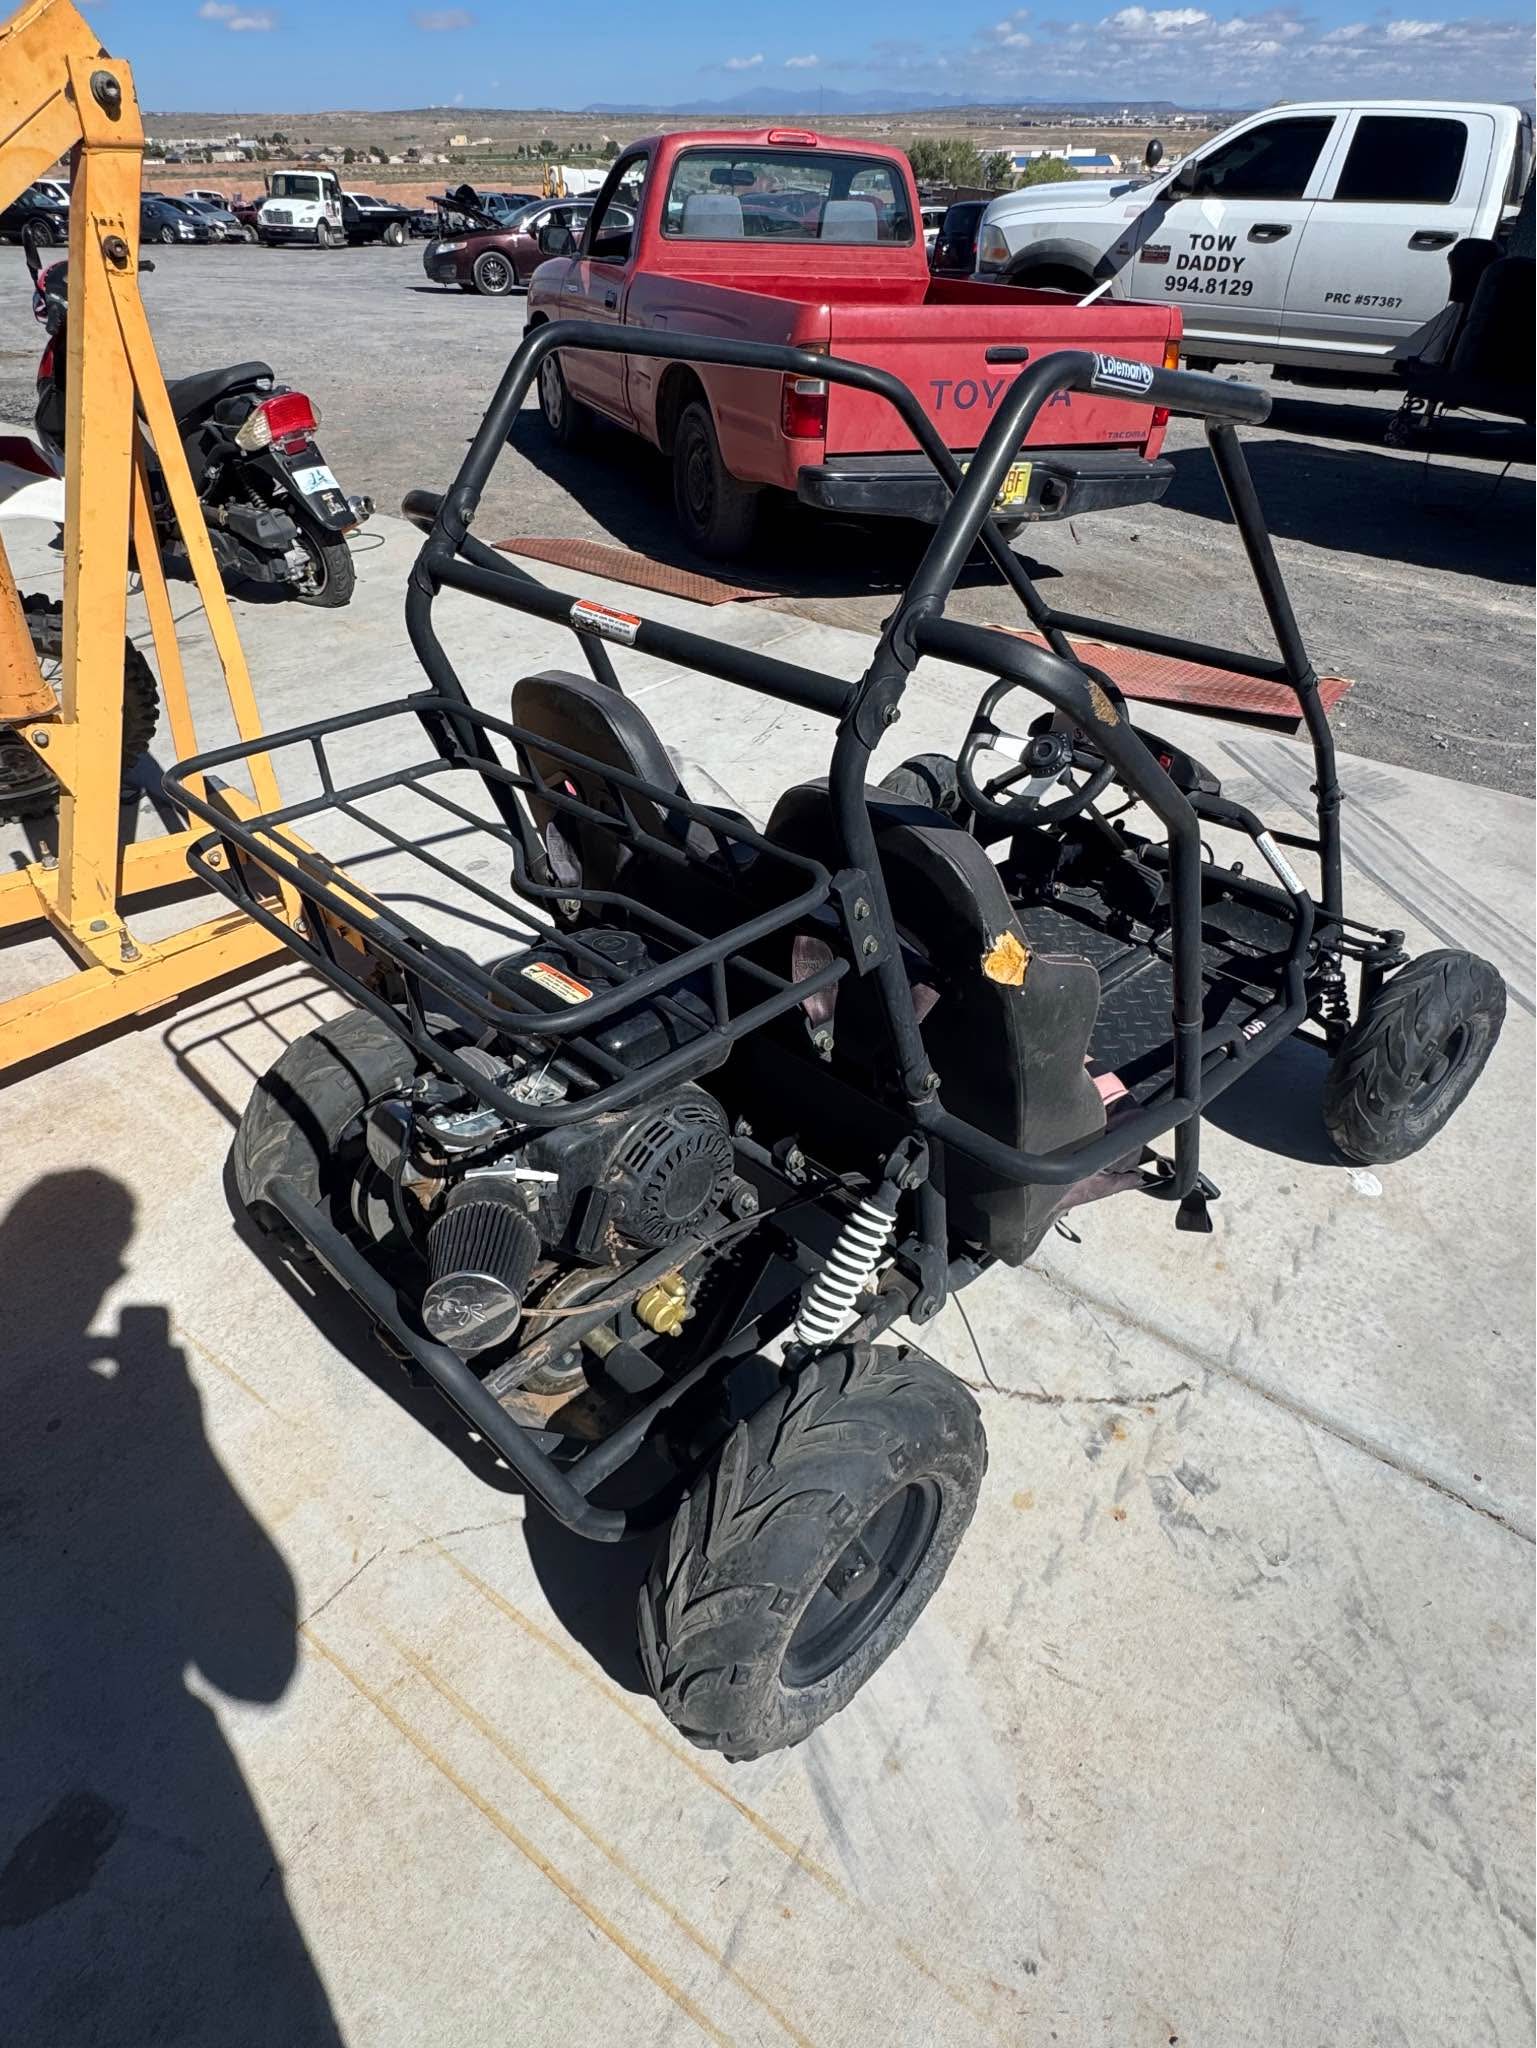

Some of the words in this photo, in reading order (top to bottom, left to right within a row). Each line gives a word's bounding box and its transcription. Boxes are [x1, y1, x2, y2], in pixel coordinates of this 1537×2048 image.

[1189, 234, 1237, 252] TOW
[1176, 254, 1246, 273] DADDY
[1164, 275, 1253, 296] 994.8129
[1324, 292, 1351, 304] PRC
[1099, 354, 1141, 381] Coleman
[929, 379, 1071, 410] TOYA
[1107, 430, 1146, 439] TACOMA
